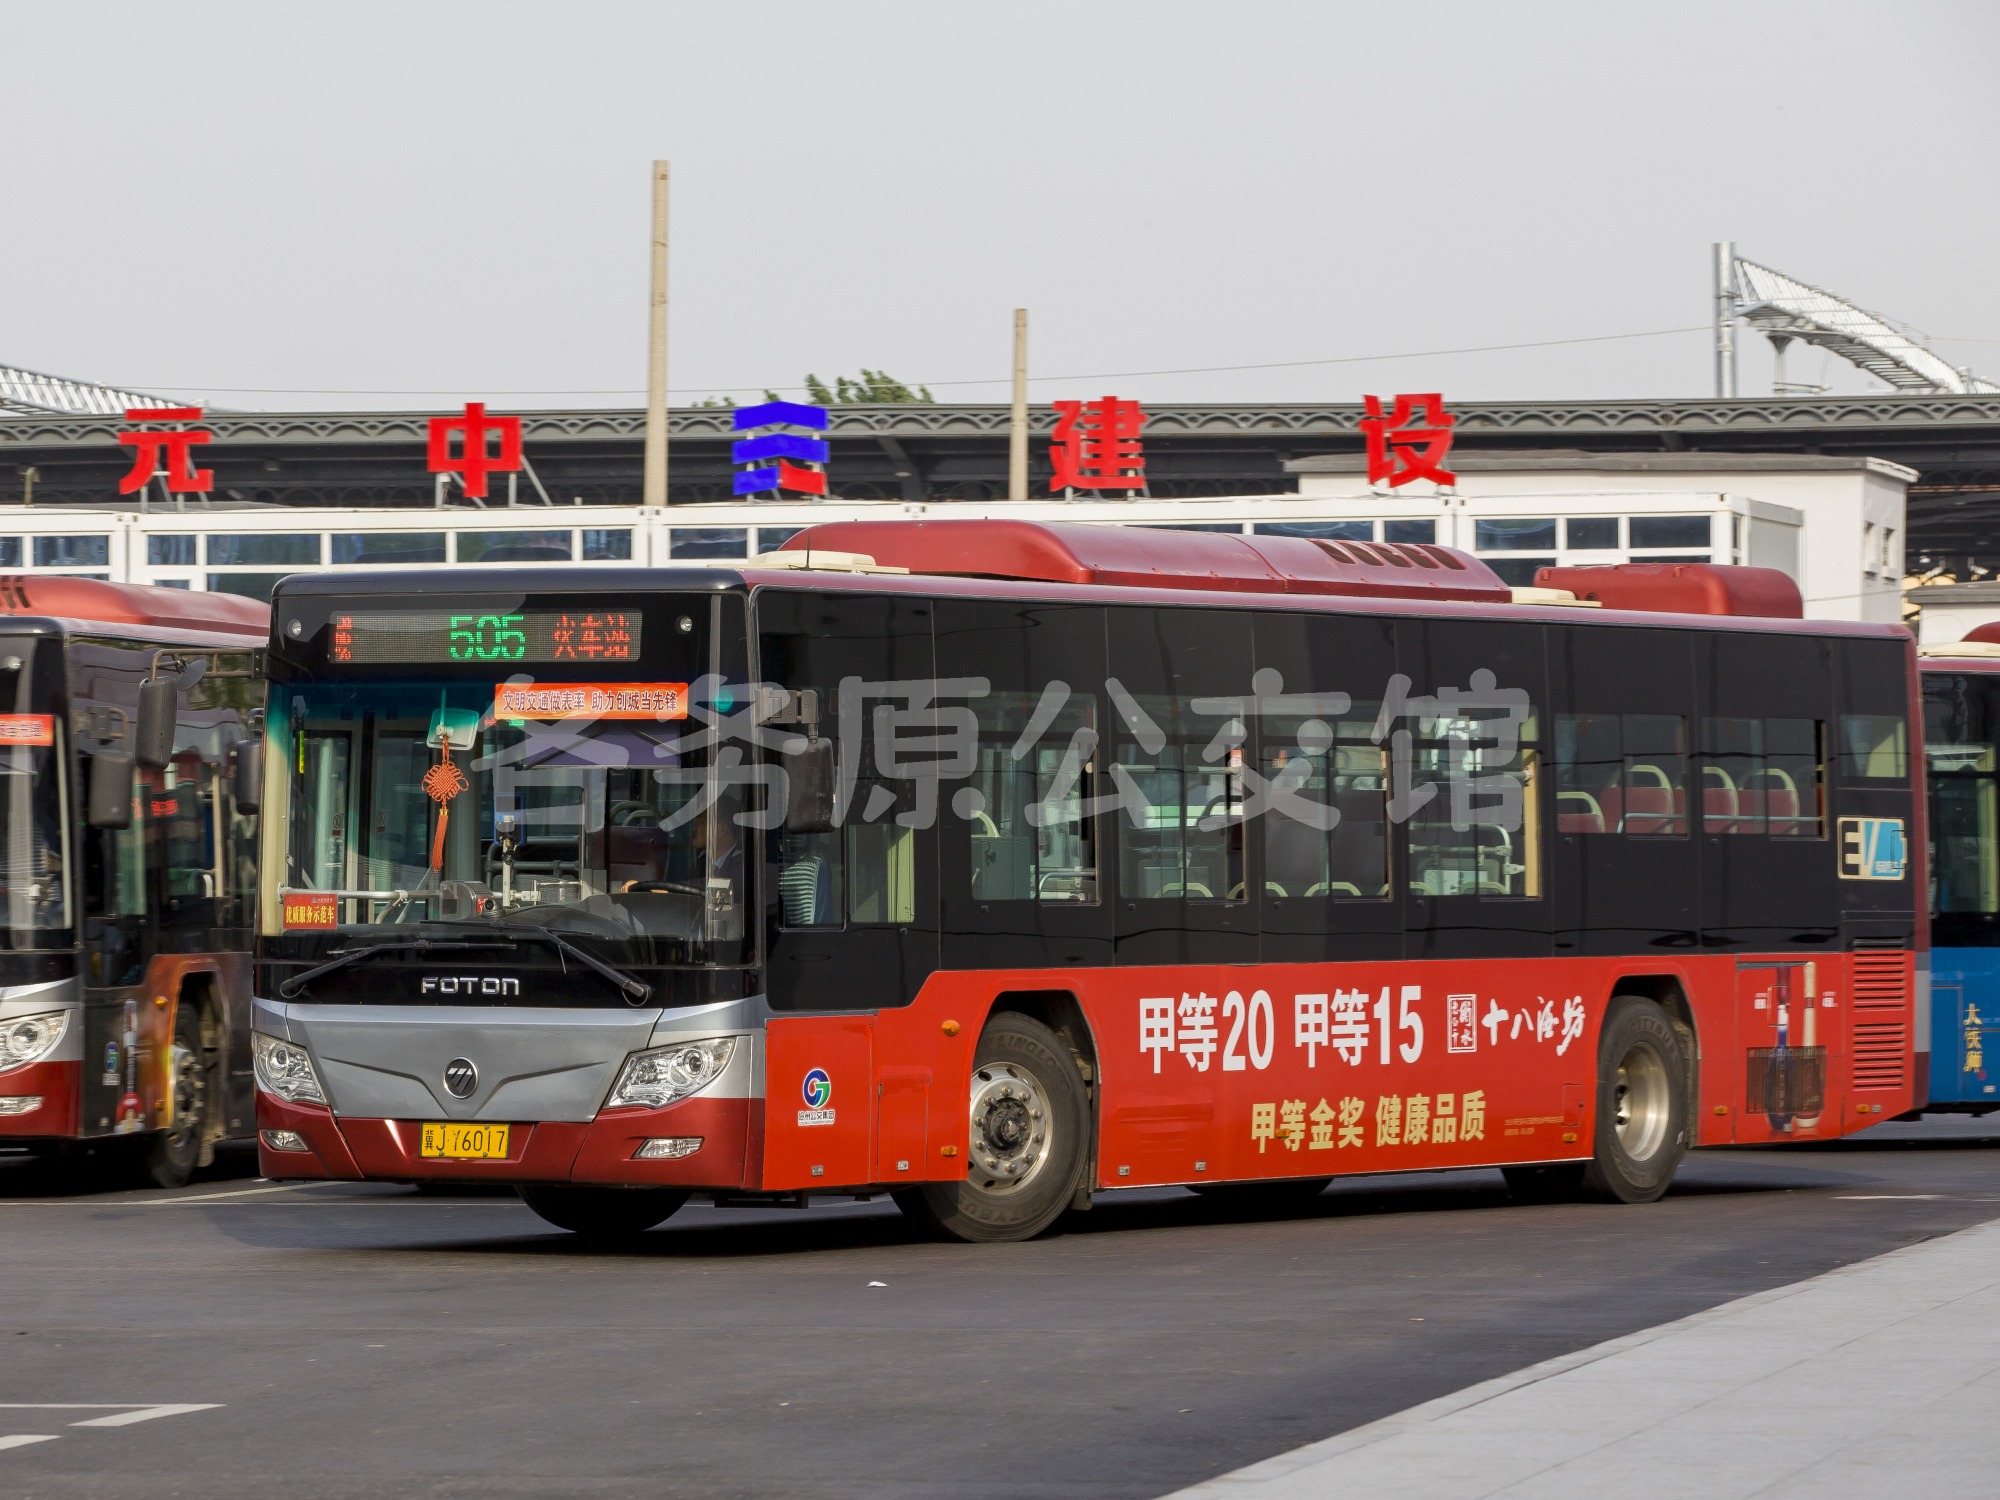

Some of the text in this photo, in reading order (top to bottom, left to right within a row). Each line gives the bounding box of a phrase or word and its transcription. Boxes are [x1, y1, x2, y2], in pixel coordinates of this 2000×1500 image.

[118, 393, 1457, 497] 元 中 建 设
[450, 614, 631, 659] 505 火车站
[502, 690, 678, 712] 文明交通做表率 助力创城当先锋
[421, 976, 519, 996] FOTON
[1139, 985, 1425, 1074] 甲等20 甲等15
[1251, 1089, 1487, 1154] 甲等金奖 健康品质
